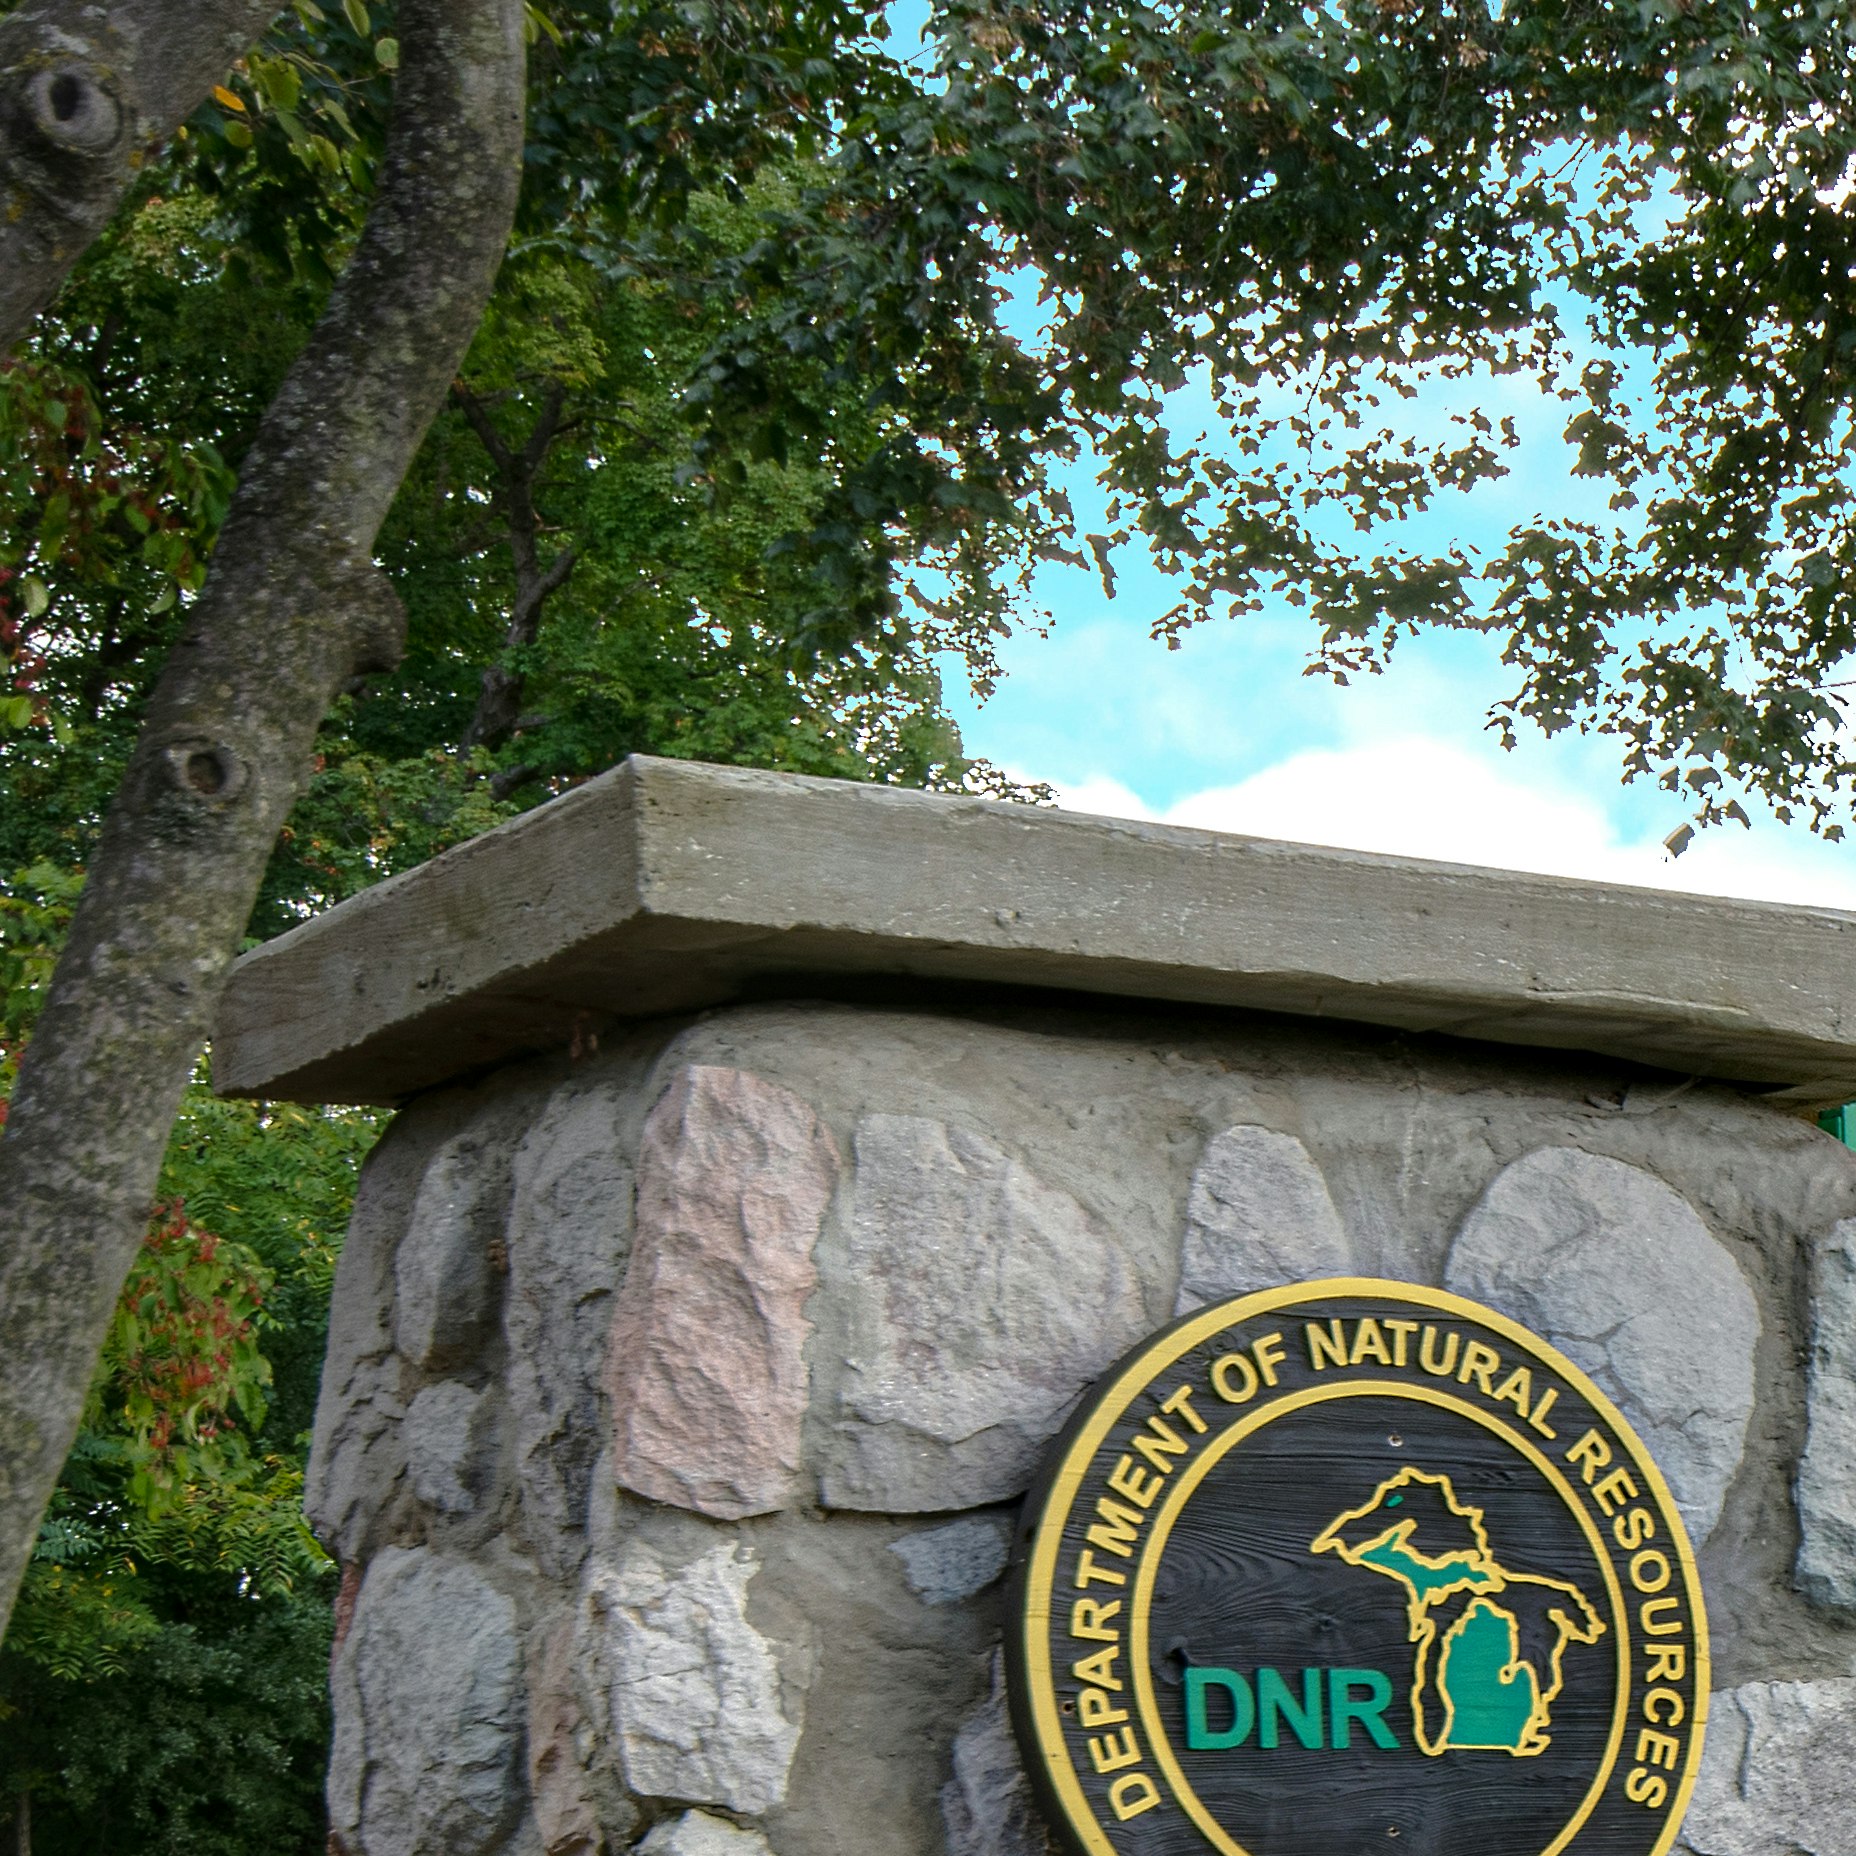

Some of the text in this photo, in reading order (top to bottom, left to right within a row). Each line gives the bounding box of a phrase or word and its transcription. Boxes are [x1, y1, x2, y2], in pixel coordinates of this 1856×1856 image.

[1070, 1318, 1686, 1822] DEPARTMENT OF NATURAL RESOURCES
[1184, 1667, 1400, 1751] DNR
